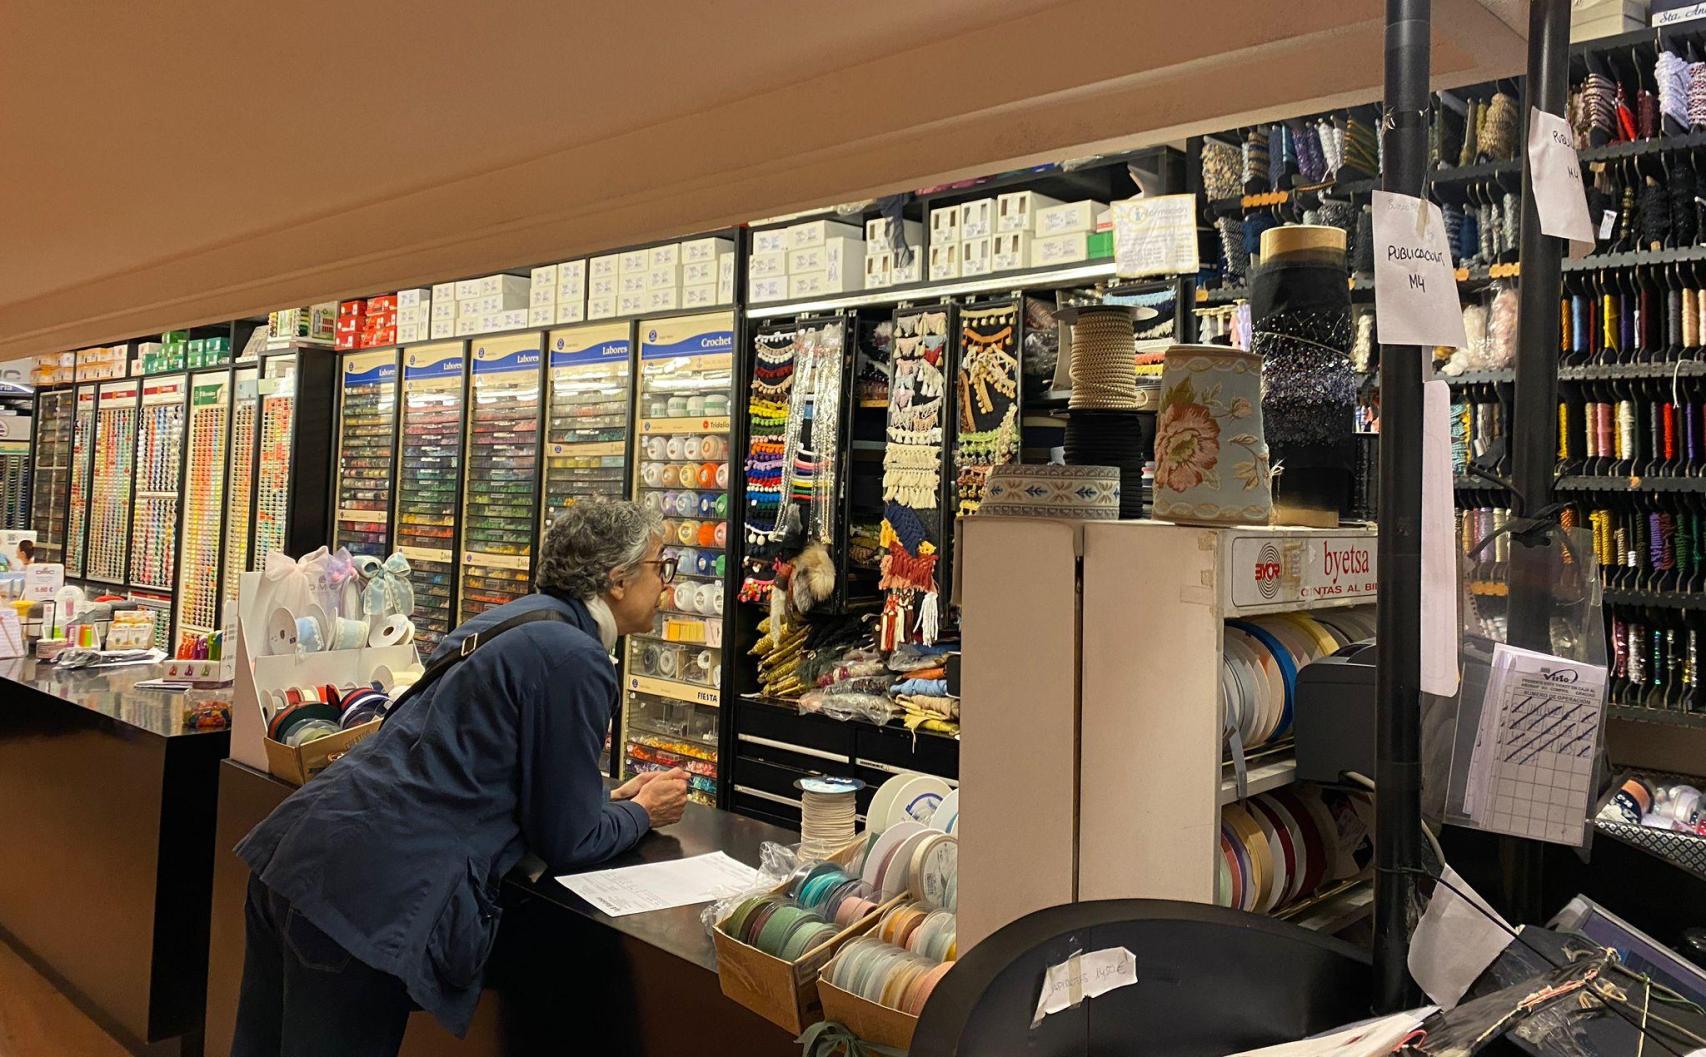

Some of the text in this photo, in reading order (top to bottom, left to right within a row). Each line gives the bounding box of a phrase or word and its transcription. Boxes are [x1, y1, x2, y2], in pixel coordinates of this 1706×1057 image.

[1685, 3, 1706, 17] An
[1408, 273, 1426, 293] M4
[701, 336, 732, 348] Crochet
[602, 345, 628, 356] Labores
[1323, 540, 1369, 584] byetsa
[1347, 584, 1361, 593] AL
[697, 691, 718, 702] FIESTA
